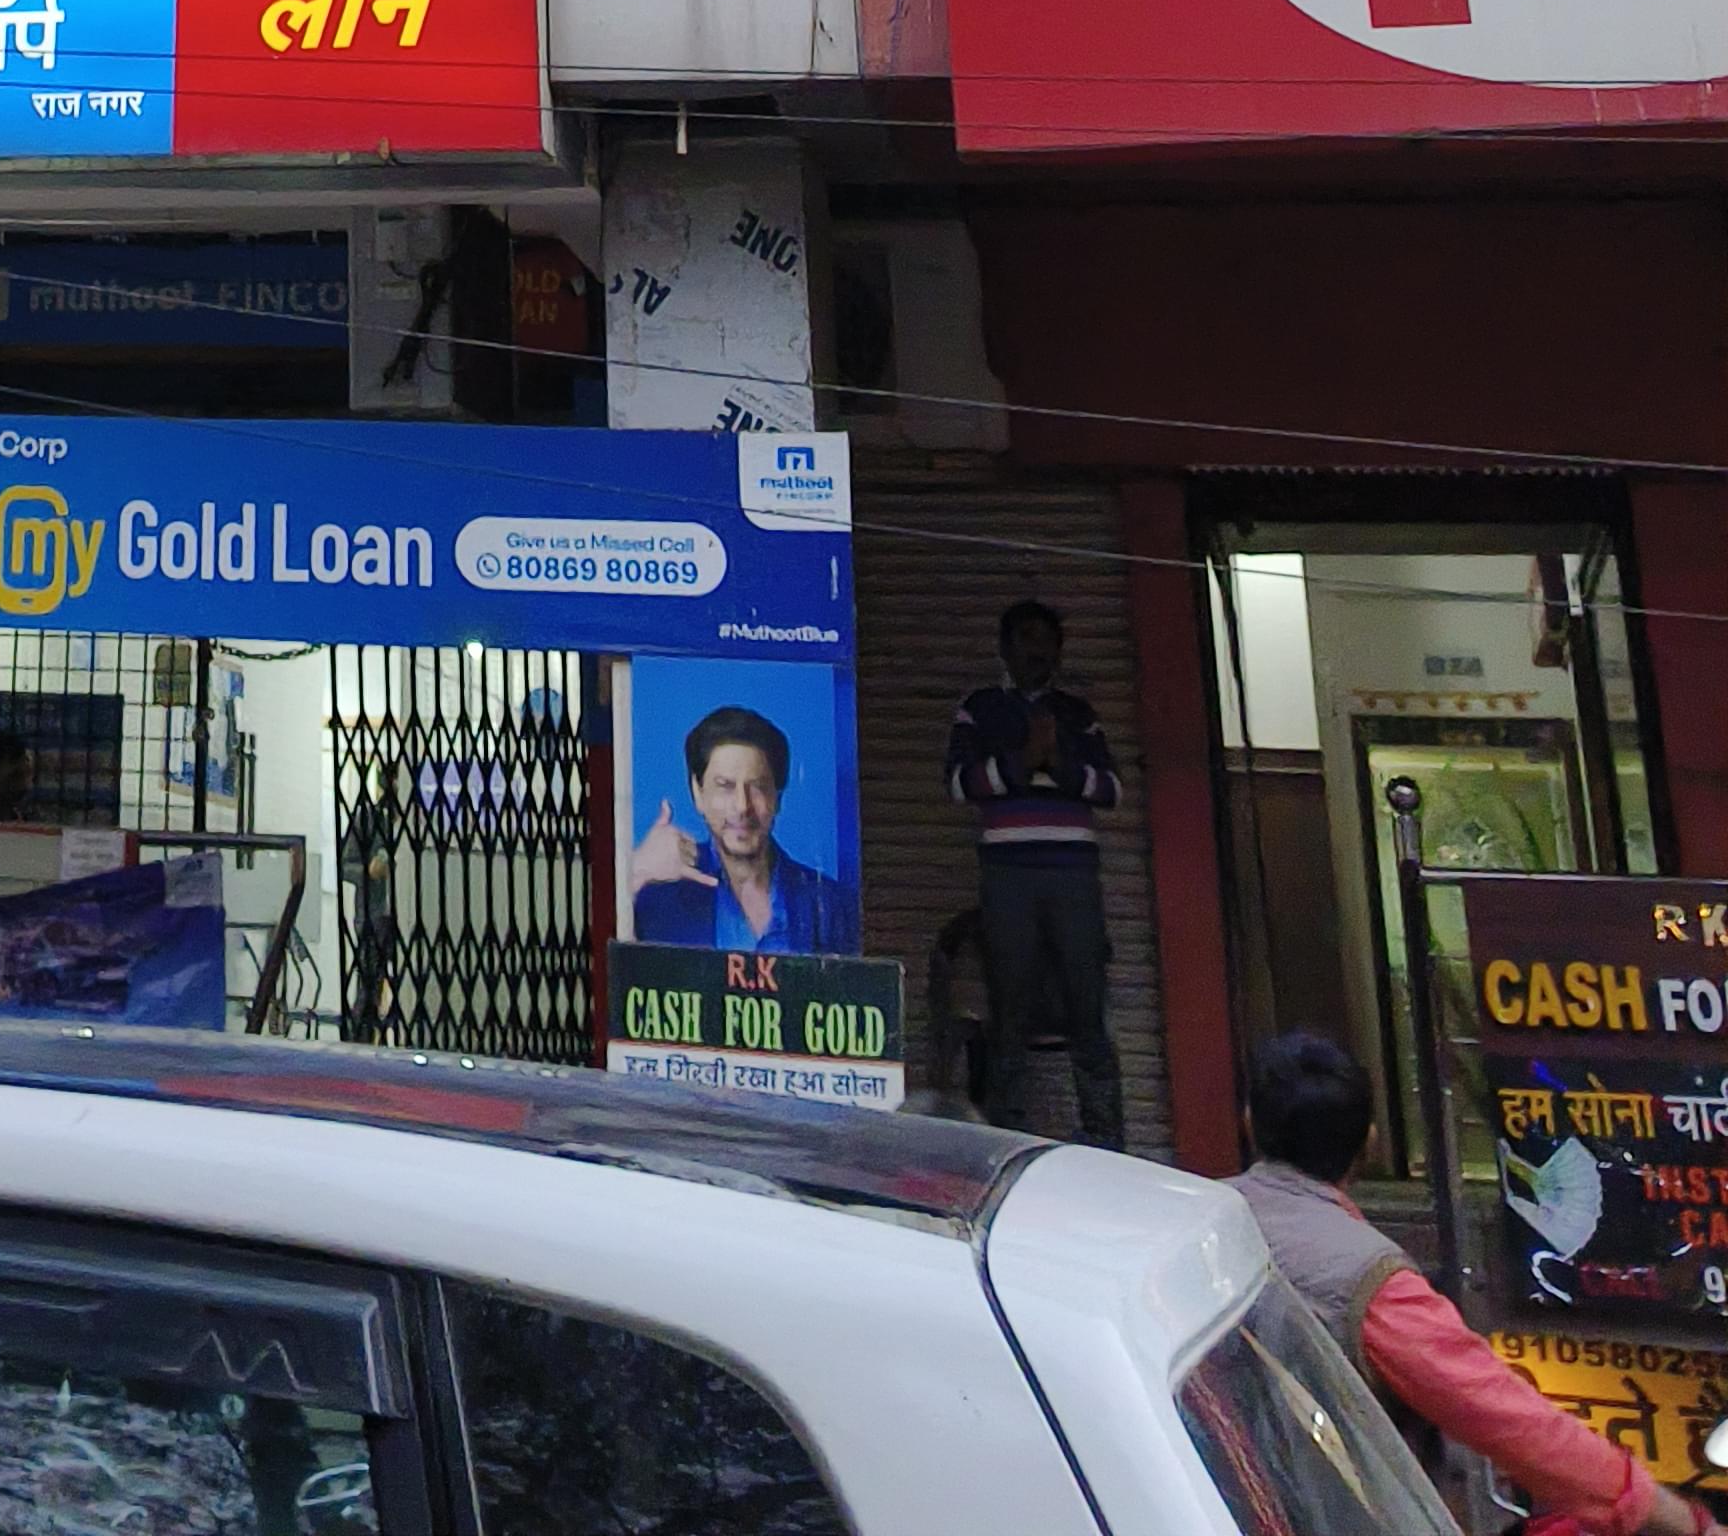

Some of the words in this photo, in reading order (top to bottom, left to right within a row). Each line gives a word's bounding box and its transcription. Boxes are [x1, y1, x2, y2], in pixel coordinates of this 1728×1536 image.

[30, 91, 86, 121] राज
[87, 91, 144, 120] नगर
[1, 504, 106, 604] my
[118, 499, 257, 582] Gold
[273, 503, 433, 588] Loan
[505, 532, 545, 550] Give
[574, 537, 586, 550] a
[659, 535, 695, 553] Call
[506, 555, 598, 582] 80869
[605, 558, 699, 585] 80869
[726, 953, 779, 992] R.K
[1482, 958, 1649, 1032] CASH
[1657, 978, 1728, 1033] FO
[624, 985, 704, 1044] CASH
[724, 993, 784, 1051] FOR
[804, 1001, 886, 1058] GOLD
[1497, 1087, 1555, 1139] हम
[1564, 1070, 1657, 1139] सोना
